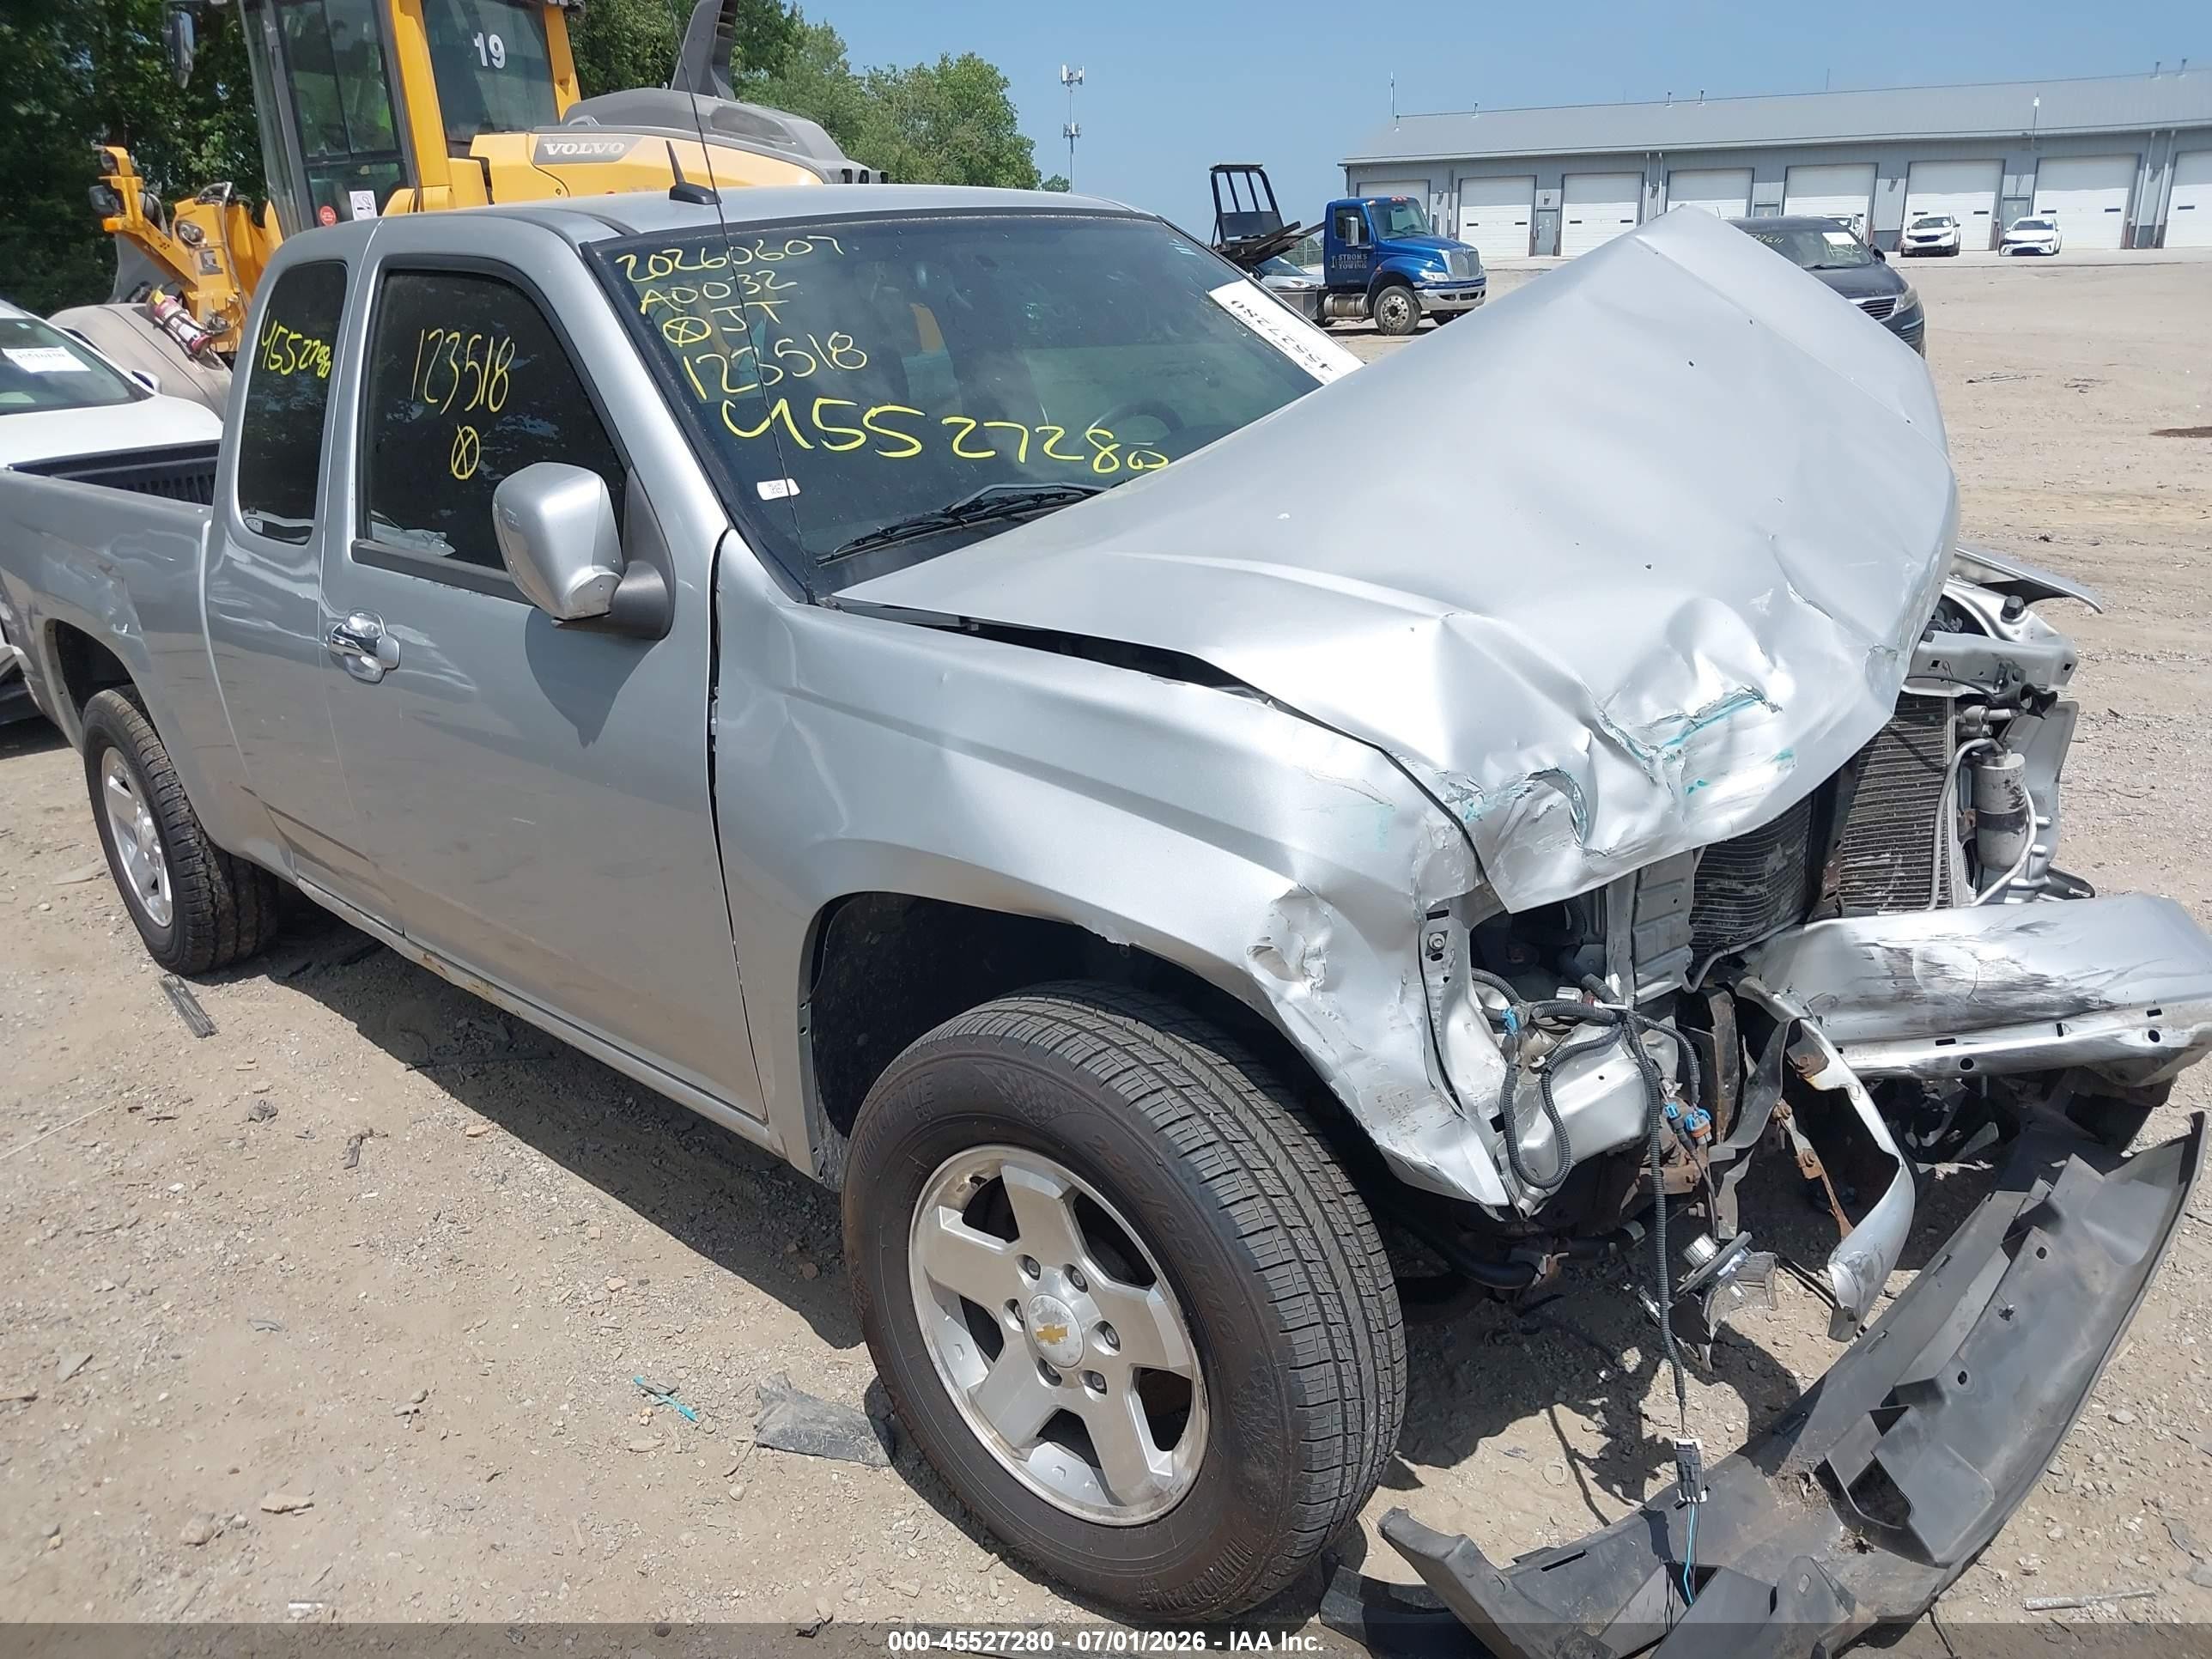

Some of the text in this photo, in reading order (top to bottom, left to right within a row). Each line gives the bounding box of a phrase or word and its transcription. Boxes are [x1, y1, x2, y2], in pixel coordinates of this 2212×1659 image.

[474, 32, 505, 69] 19
[544, 143, 625, 155] VOLVO
[616, 235, 844, 282] 20260607
[640, 270, 797, 314] A0032
[411, 328, 515, 415] 123518
[683, 331, 868, 400] 123518
[721, 398, 1170, 473] 45527280
